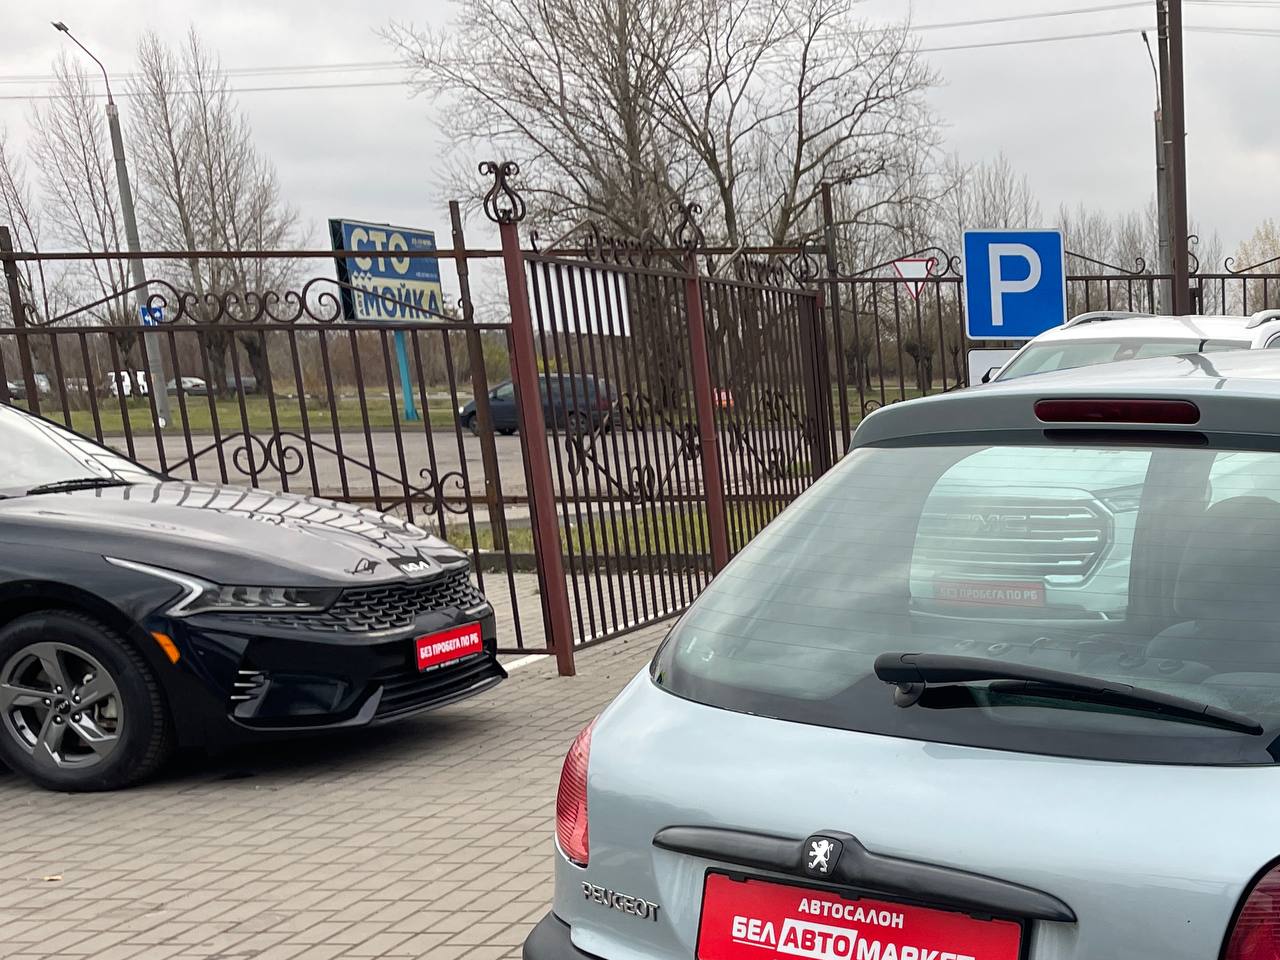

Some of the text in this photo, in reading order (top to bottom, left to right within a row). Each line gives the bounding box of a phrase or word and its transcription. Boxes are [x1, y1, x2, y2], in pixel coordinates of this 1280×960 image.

[351, 228, 411, 274] СТО
[362, 283, 440, 319] МОЙКА
[988, 243, 1042, 326] P
[420, 645, 432, 660] БЕЗ
[432, 637, 461, 656] ПРОБЕГА
[460, 635, 470, 648] ПО
[581, 881, 660, 922] PEUGEOT
[798, 897, 905, 930] АВТОСАЛОН
